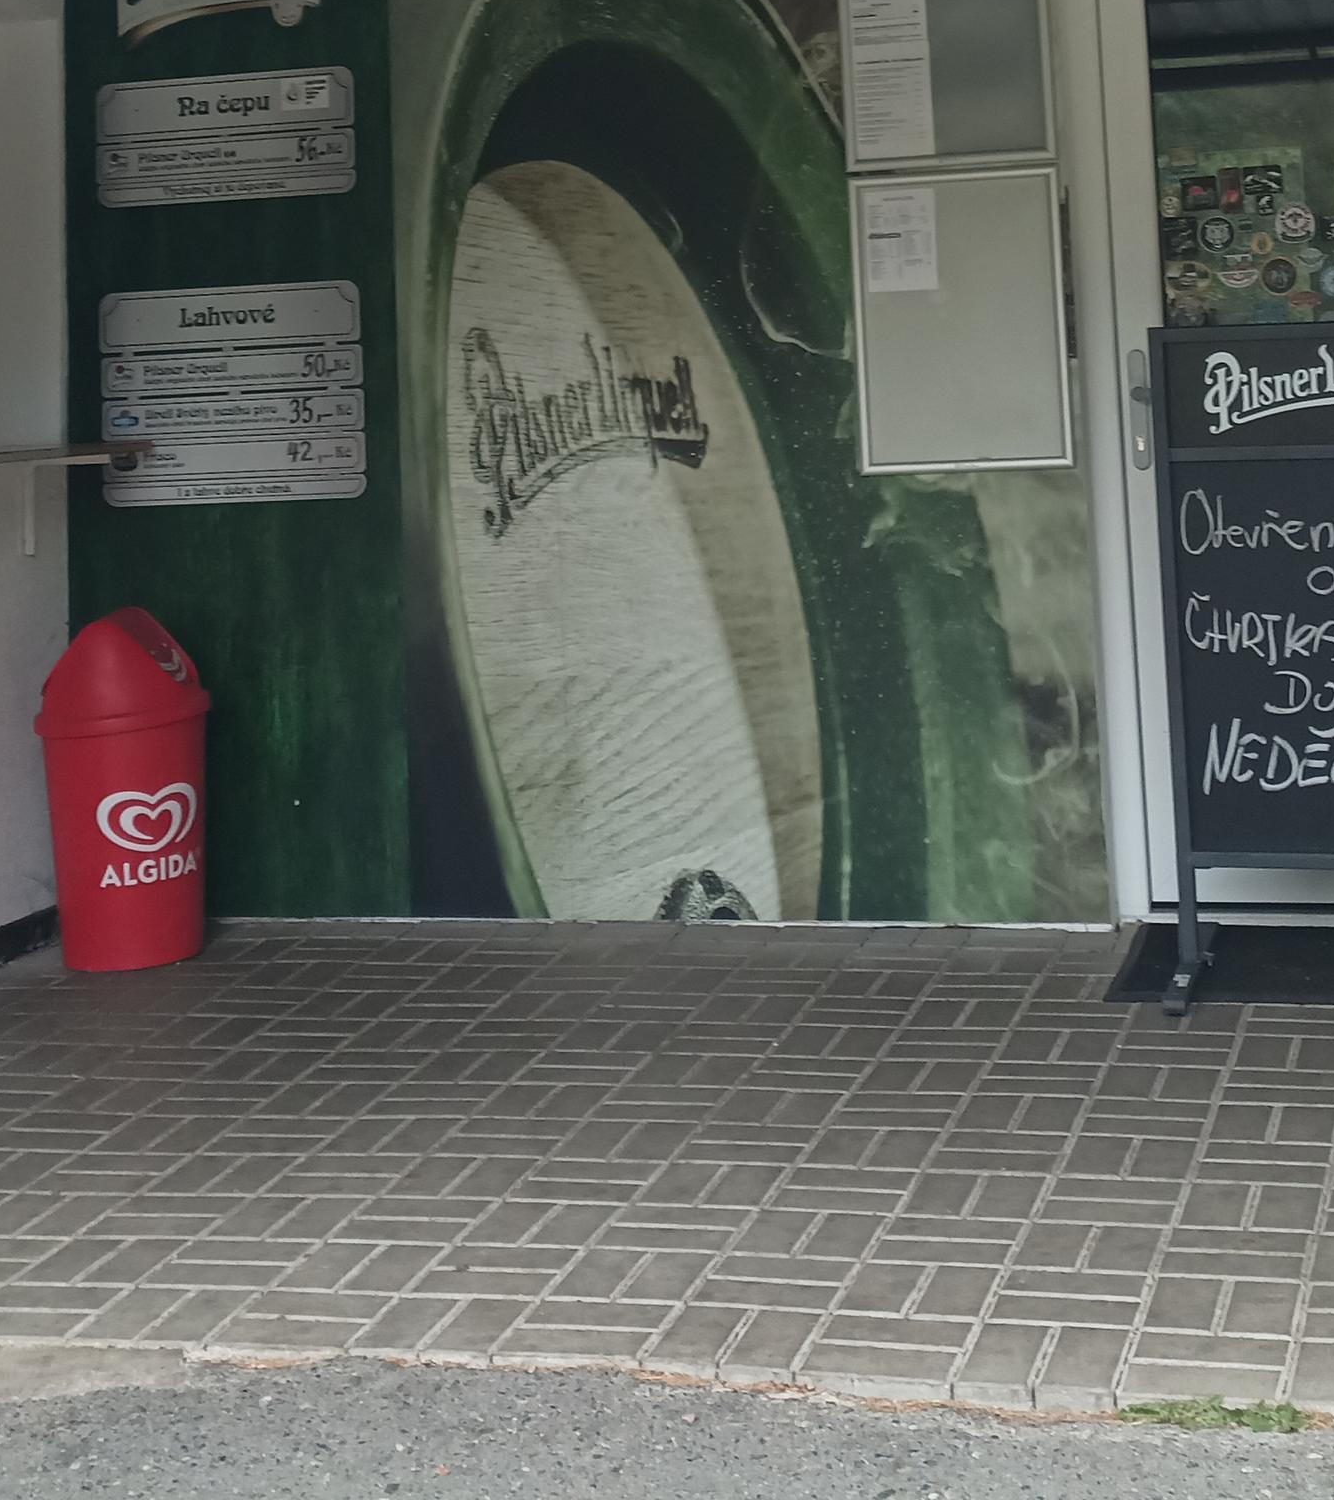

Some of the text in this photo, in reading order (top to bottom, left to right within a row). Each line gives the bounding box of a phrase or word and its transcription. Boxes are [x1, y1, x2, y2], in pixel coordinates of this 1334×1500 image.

[216, 94, 270, 117] čepu
[178, 304, 276, 328] Lahvové
[1203, 351, 1325, 434] Pilsner
[462, 327, 700, 539] Pilsner Urquell
[100, 851, 197, 888] ALGIDA
